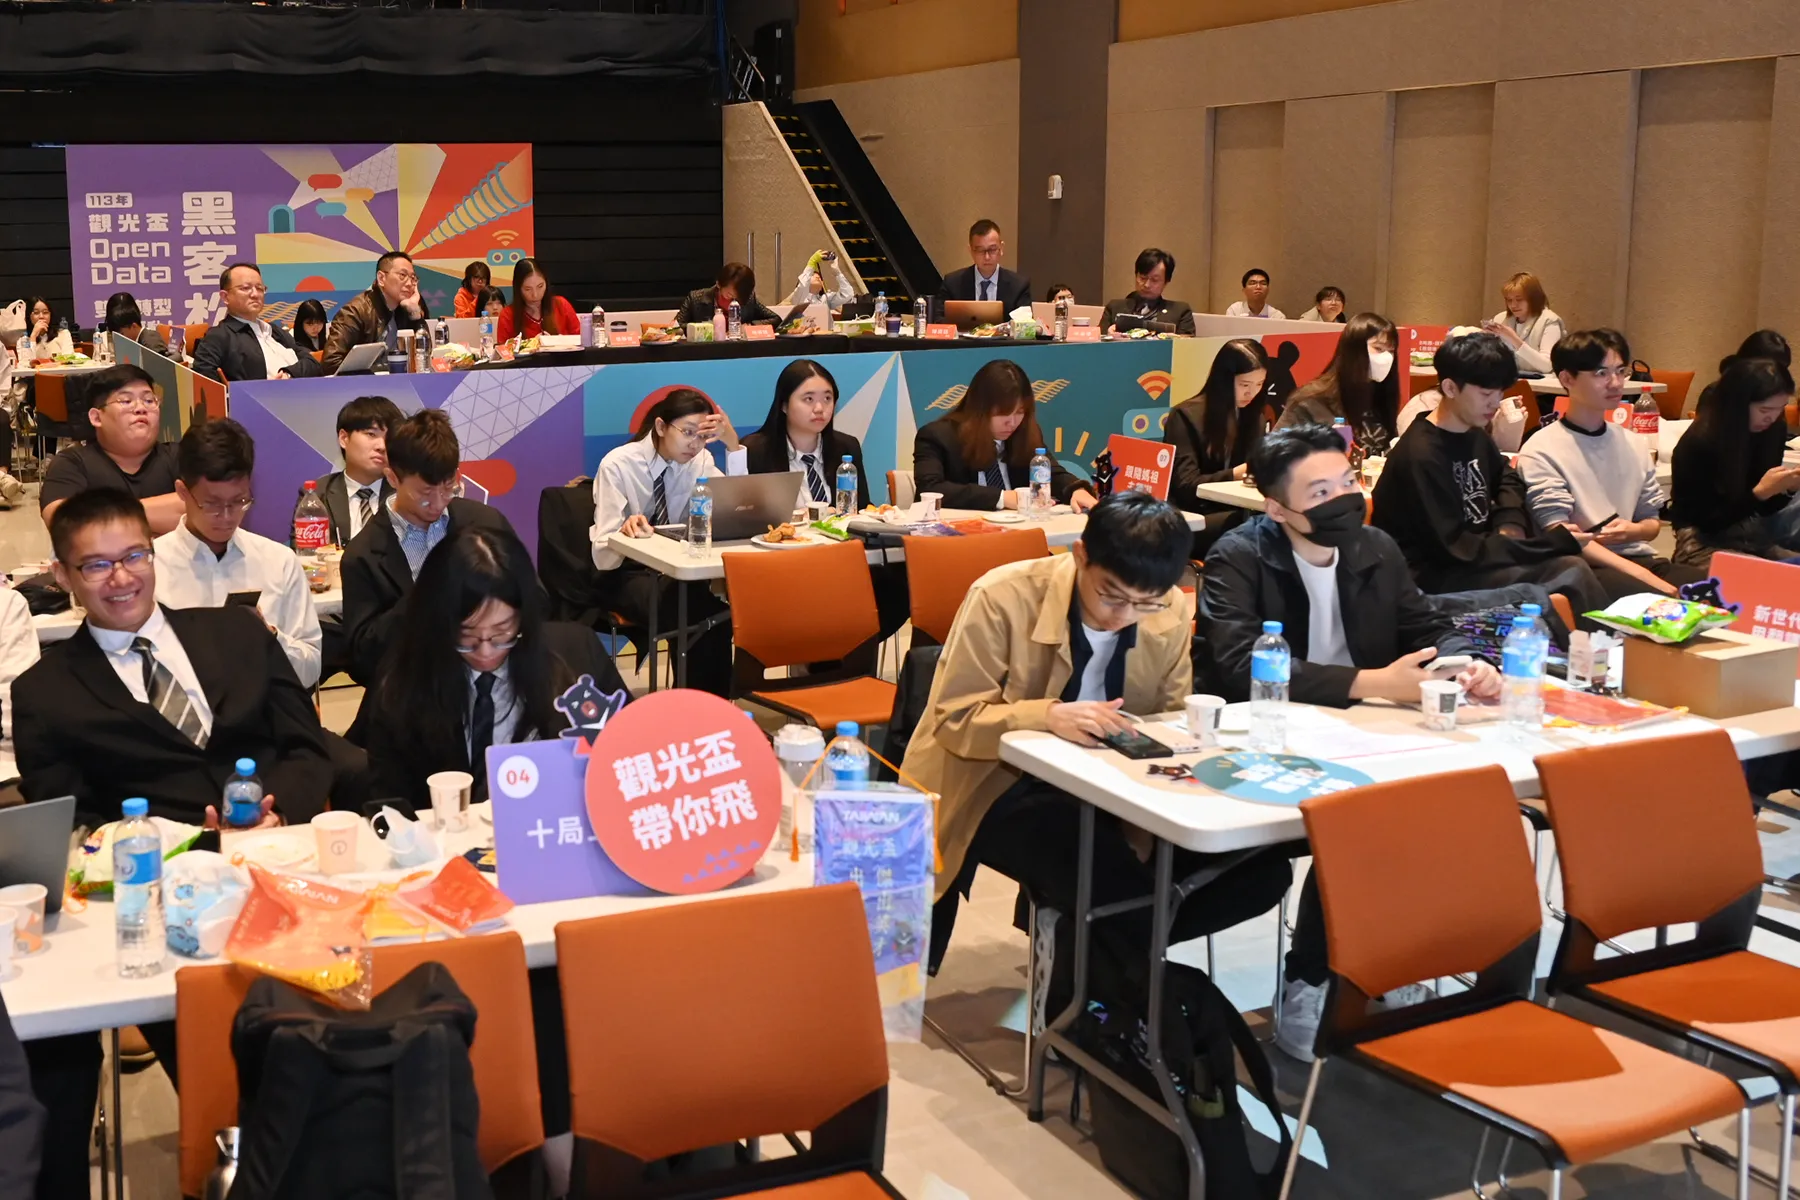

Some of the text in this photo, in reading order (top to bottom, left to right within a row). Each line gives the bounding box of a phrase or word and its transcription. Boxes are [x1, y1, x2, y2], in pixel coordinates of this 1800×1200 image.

[89, 195, 129, 206] 113年
[88, 212, 169, 233] 觀光盃
[89, 238, 170, 261] Open
[91, 262, 172, 285] Data
[303, 523, 325, 539] Cola
[612, 729, 741, 802] 觀光盃
[505, 768, 530, 786] 04
[629, 779, 758, 851] 帶你飛
[842, 810, 900, 824] TAIWAN
[526, 816, 602, 850] 十局
